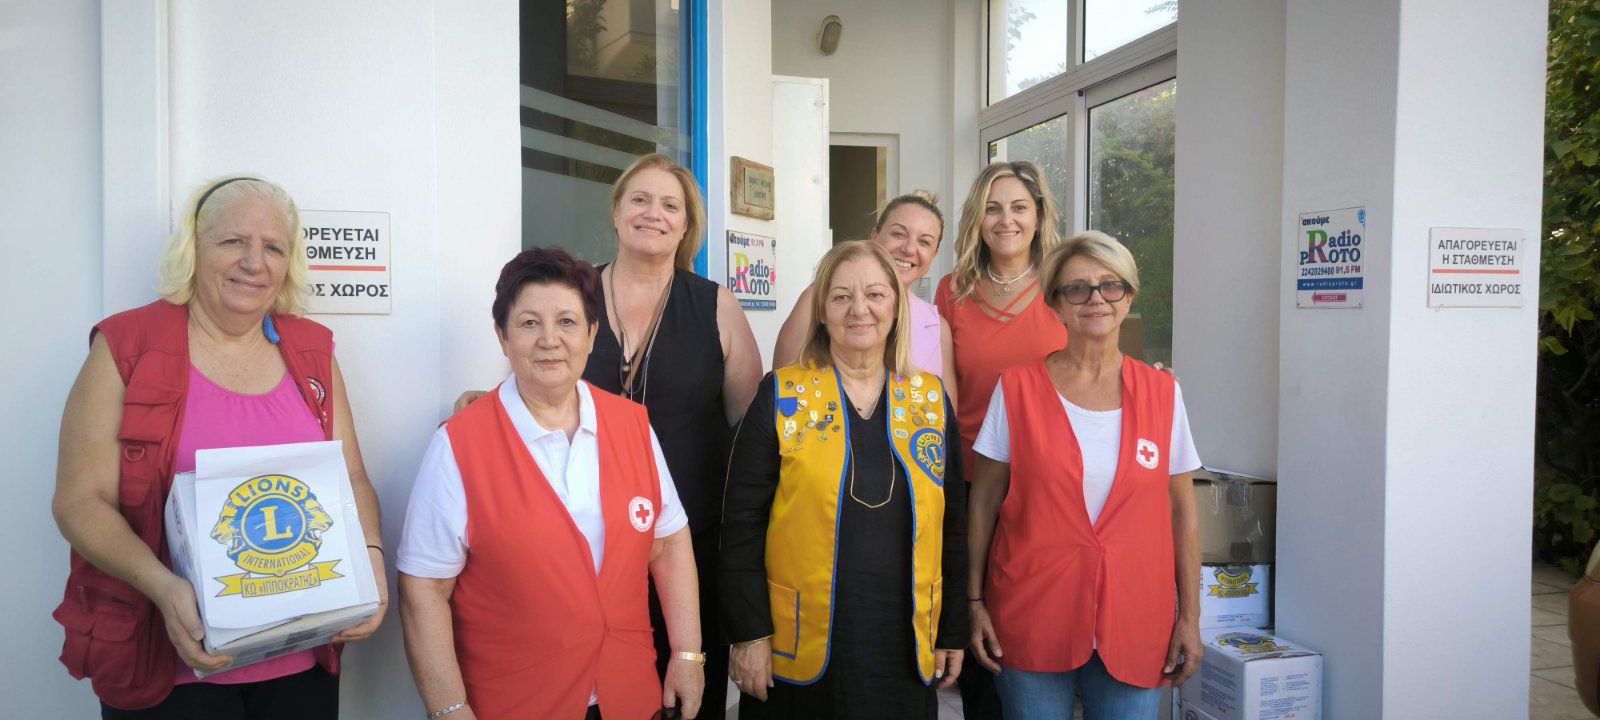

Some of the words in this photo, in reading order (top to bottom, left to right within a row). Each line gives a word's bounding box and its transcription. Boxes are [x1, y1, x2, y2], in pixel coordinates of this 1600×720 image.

[1307, 229, 1361, 250] Radio
[1438, 240, 1517, 251] ΑΠΑΓΟΡΕΥΕΤΑΙ
[734, 253, 769, 278] Radio
[1442, 254, 1450, 265] Η
[1452, 254, 1515, 266] ΣΤΑΘΜΕΥΣΗ
[1351, 265, 1360, 273] FM
[330, 284, 389, 297] ΧΩΡΟΣ
[1431, 283, 1482, 294] ΙΔΙΩΤΙΚΟΣ
[1485, 283, 1521, 295] ΧΩΡΟΣ
[235, 478, 304, 503] LIONS
[259, 505, 294, 542] L
[242, 547, 312, 569] INTERNATIONAL
[244, 582, 257, 595] ΚΩ
